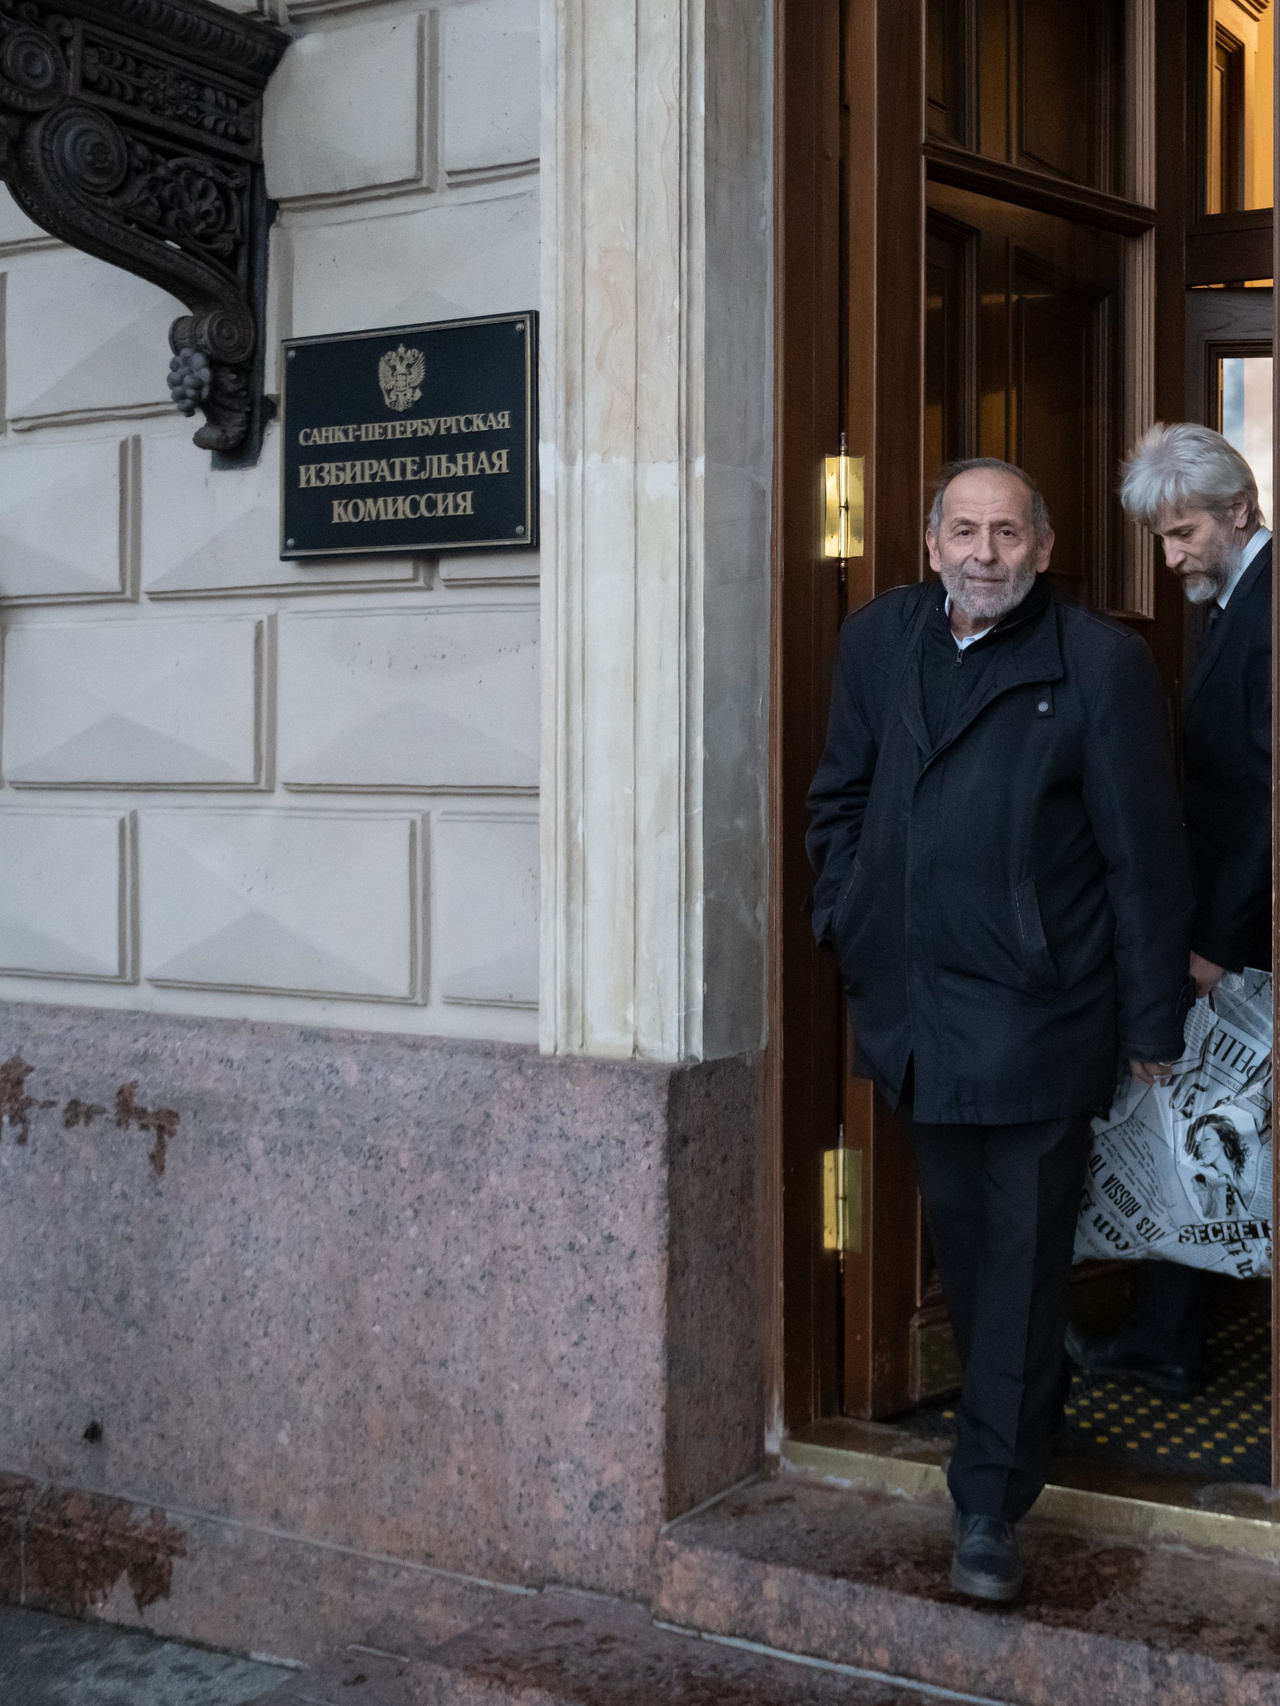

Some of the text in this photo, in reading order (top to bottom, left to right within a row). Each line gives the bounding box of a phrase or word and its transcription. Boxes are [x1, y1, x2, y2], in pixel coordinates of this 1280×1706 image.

[299, 411, 511, 446] САНКТ-ПЕТЕРБУРГСКАЯ
[299, 449, 510, 488] ИЗБИРАТЕЛЬНАЯ
[331, 491, 474, 523] КОМИССИЯ
[1089, 1154, 1107, 1178] TO
[1101, 1173, 1142, 1219] RUSSIA
